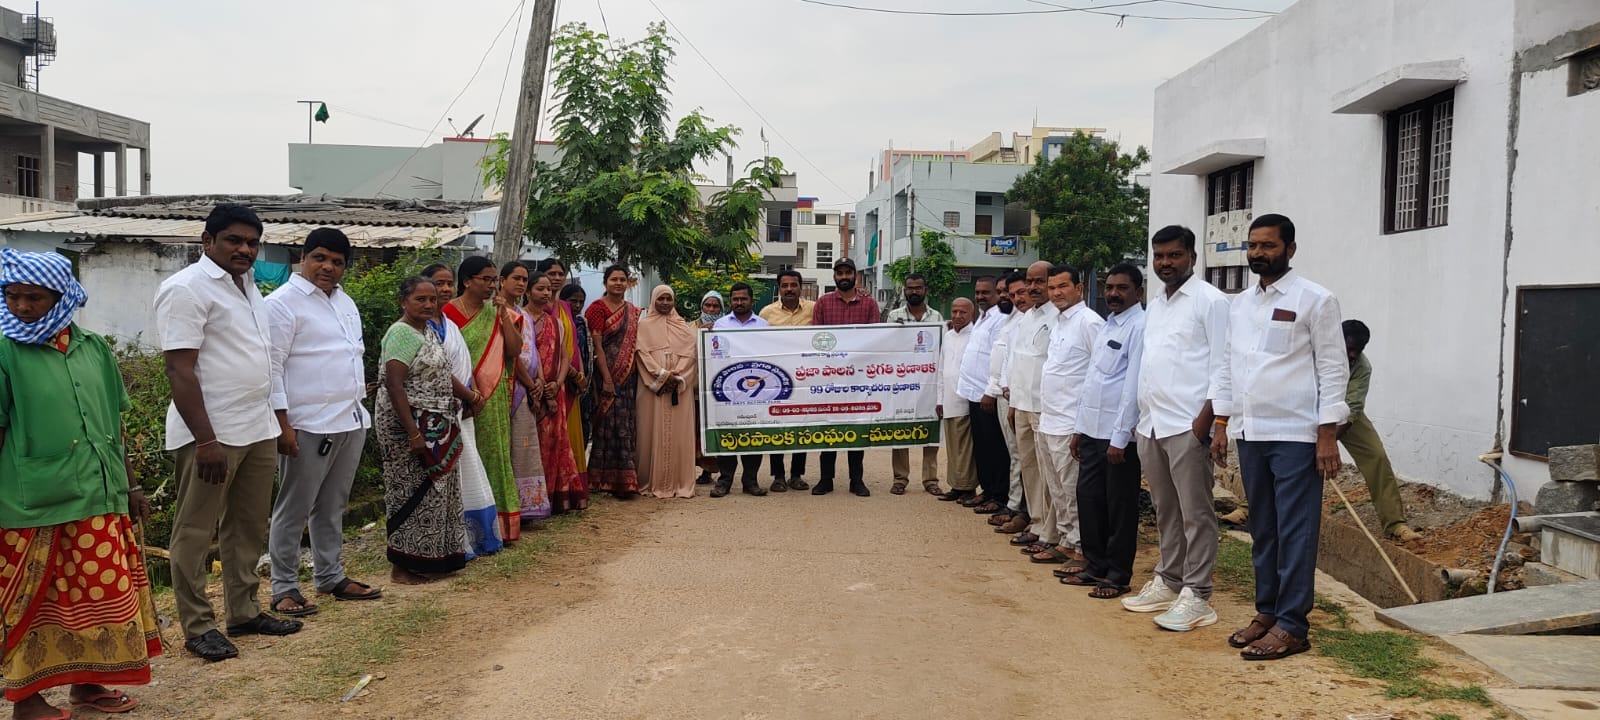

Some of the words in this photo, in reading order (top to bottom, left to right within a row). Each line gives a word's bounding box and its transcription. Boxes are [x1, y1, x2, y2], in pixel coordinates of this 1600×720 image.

[795, 365, 820, 380] ప్రజా
[822, 364, 855, 376] పాలన
[866, 362, 894, 379] ప్రగతి
[810, 385, 823, 394] 99
[720, 430, 795, 451] పురపాలక
[798, 428, 857, 446] సంఘం
